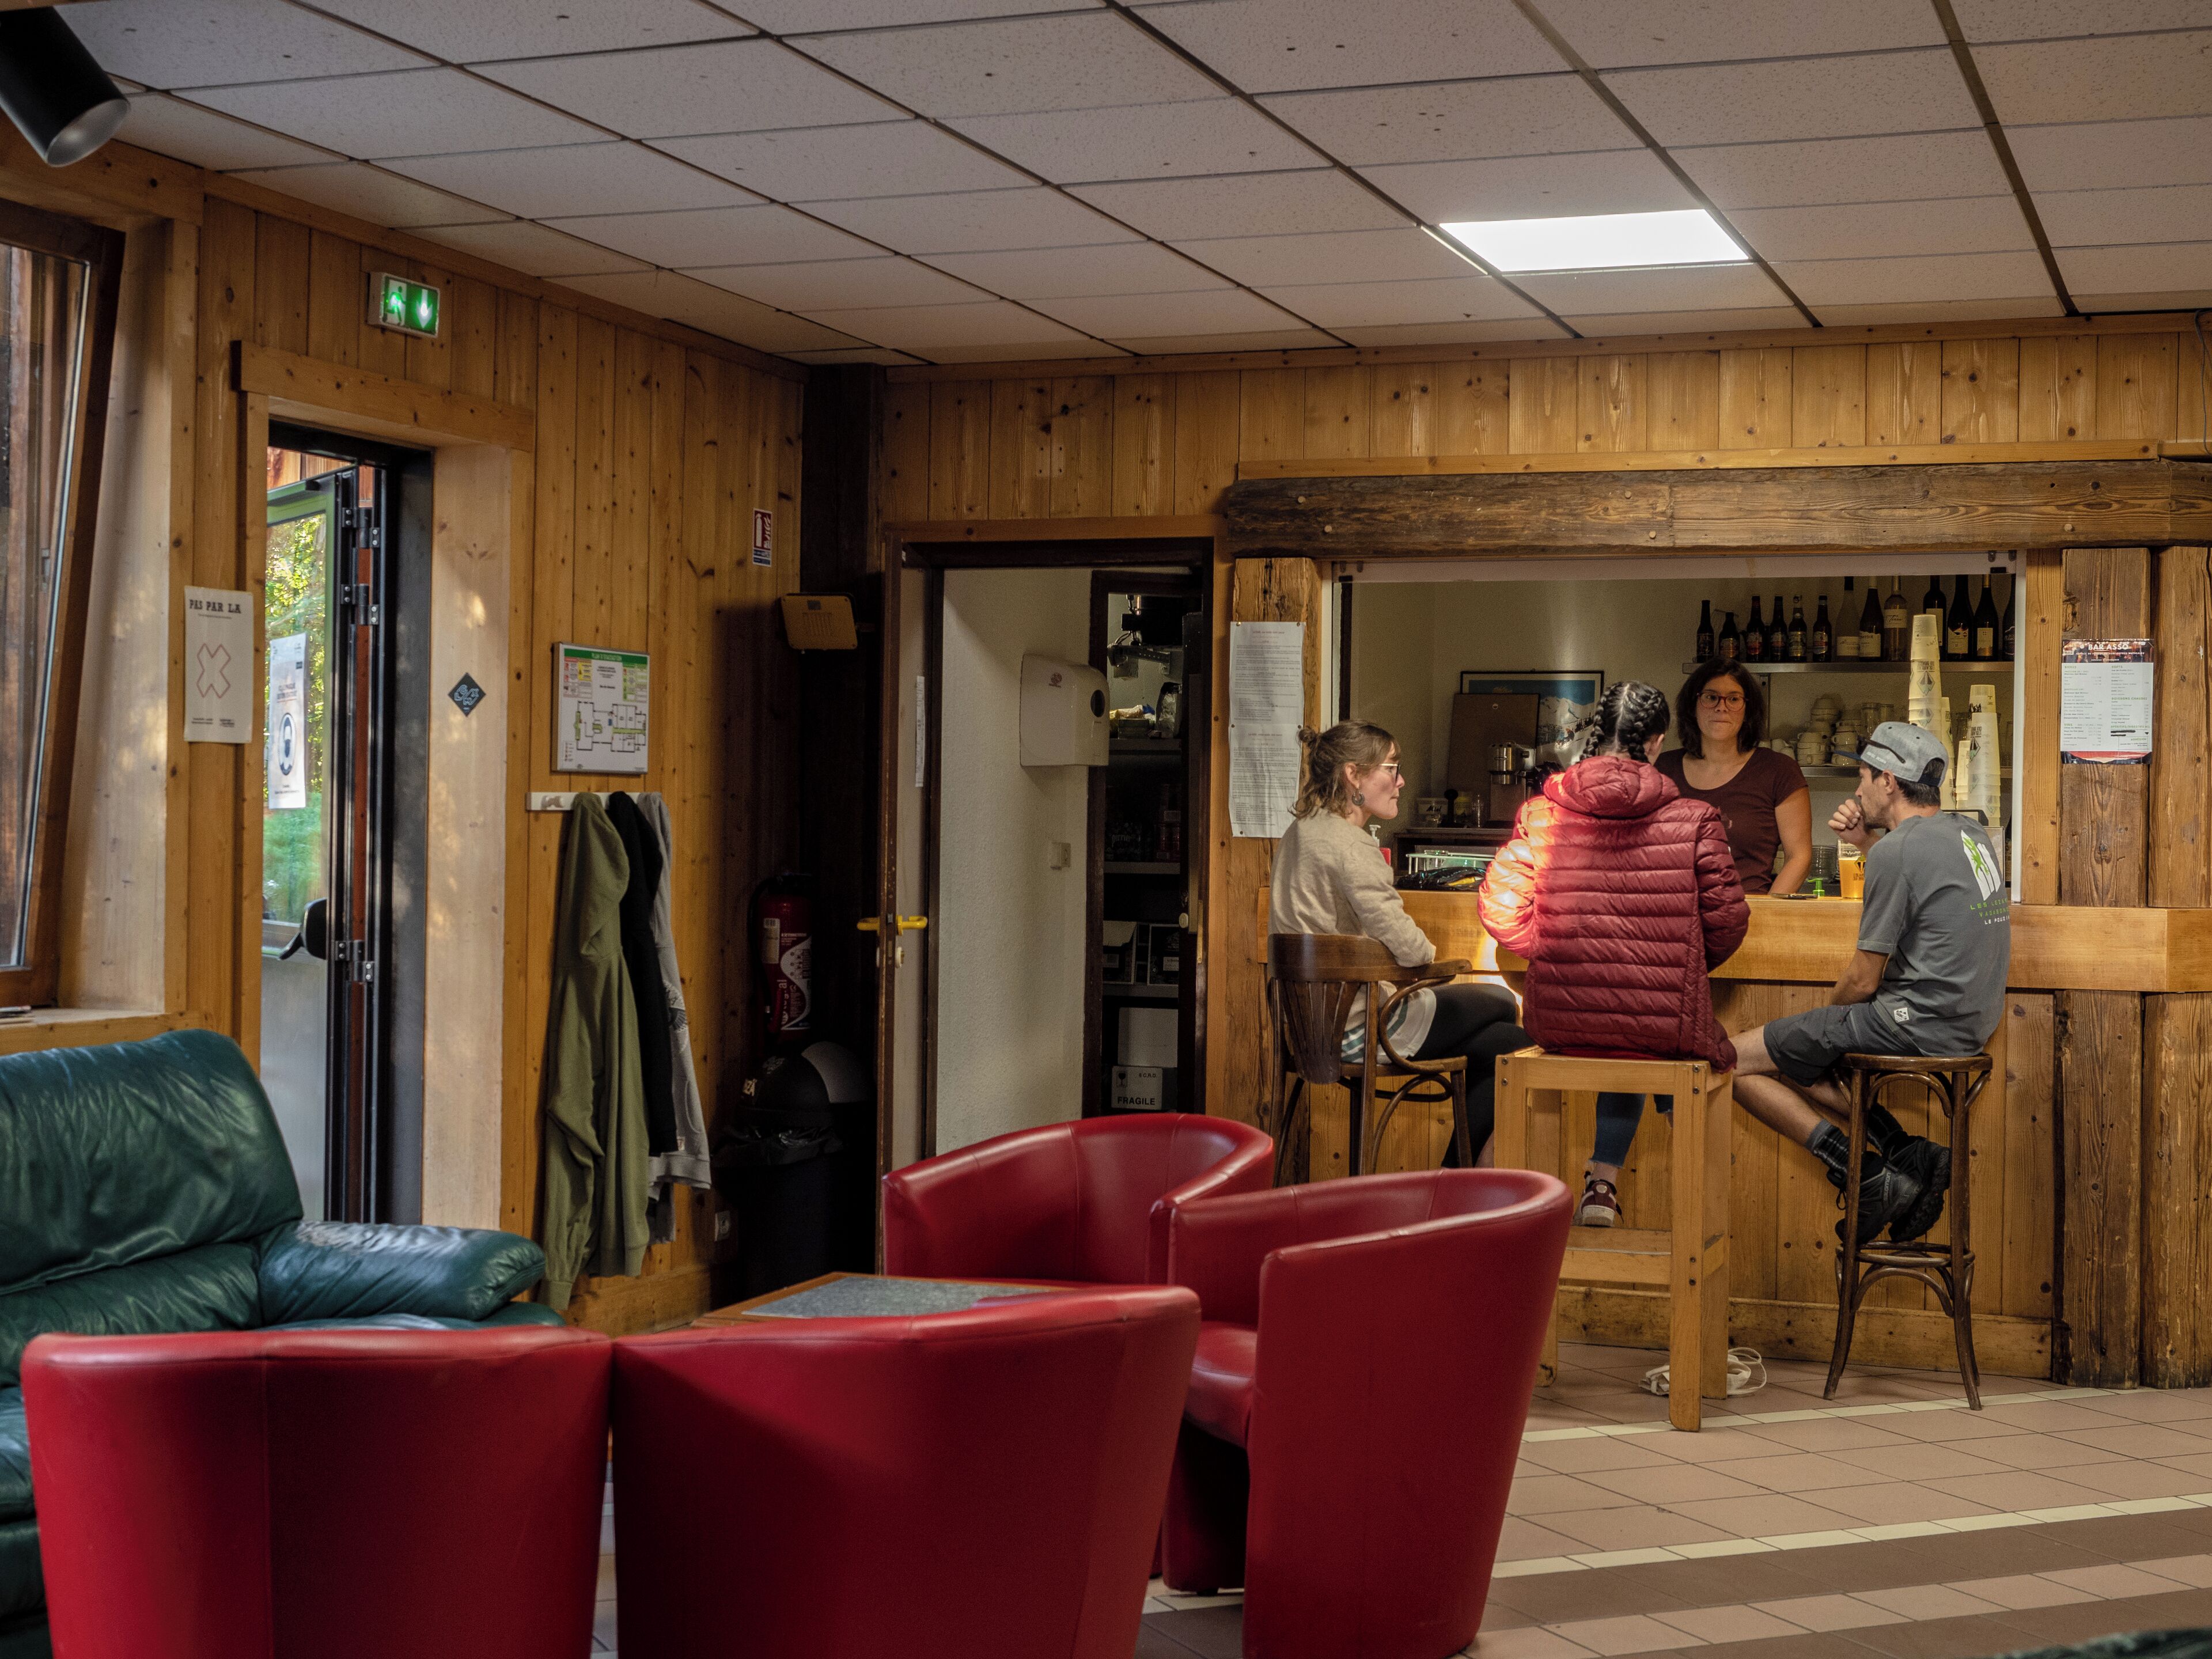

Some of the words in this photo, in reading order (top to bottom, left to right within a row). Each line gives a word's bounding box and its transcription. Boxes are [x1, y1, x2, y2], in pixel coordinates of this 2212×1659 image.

[189, 599, 203, 609] PAS
[206, 601, 224, 612] PAR
[228, 603, 241, 613] LA
[1969, 902, 1988, 911] LES
[1118, 1096, 1156, 1105] FRAGILE
